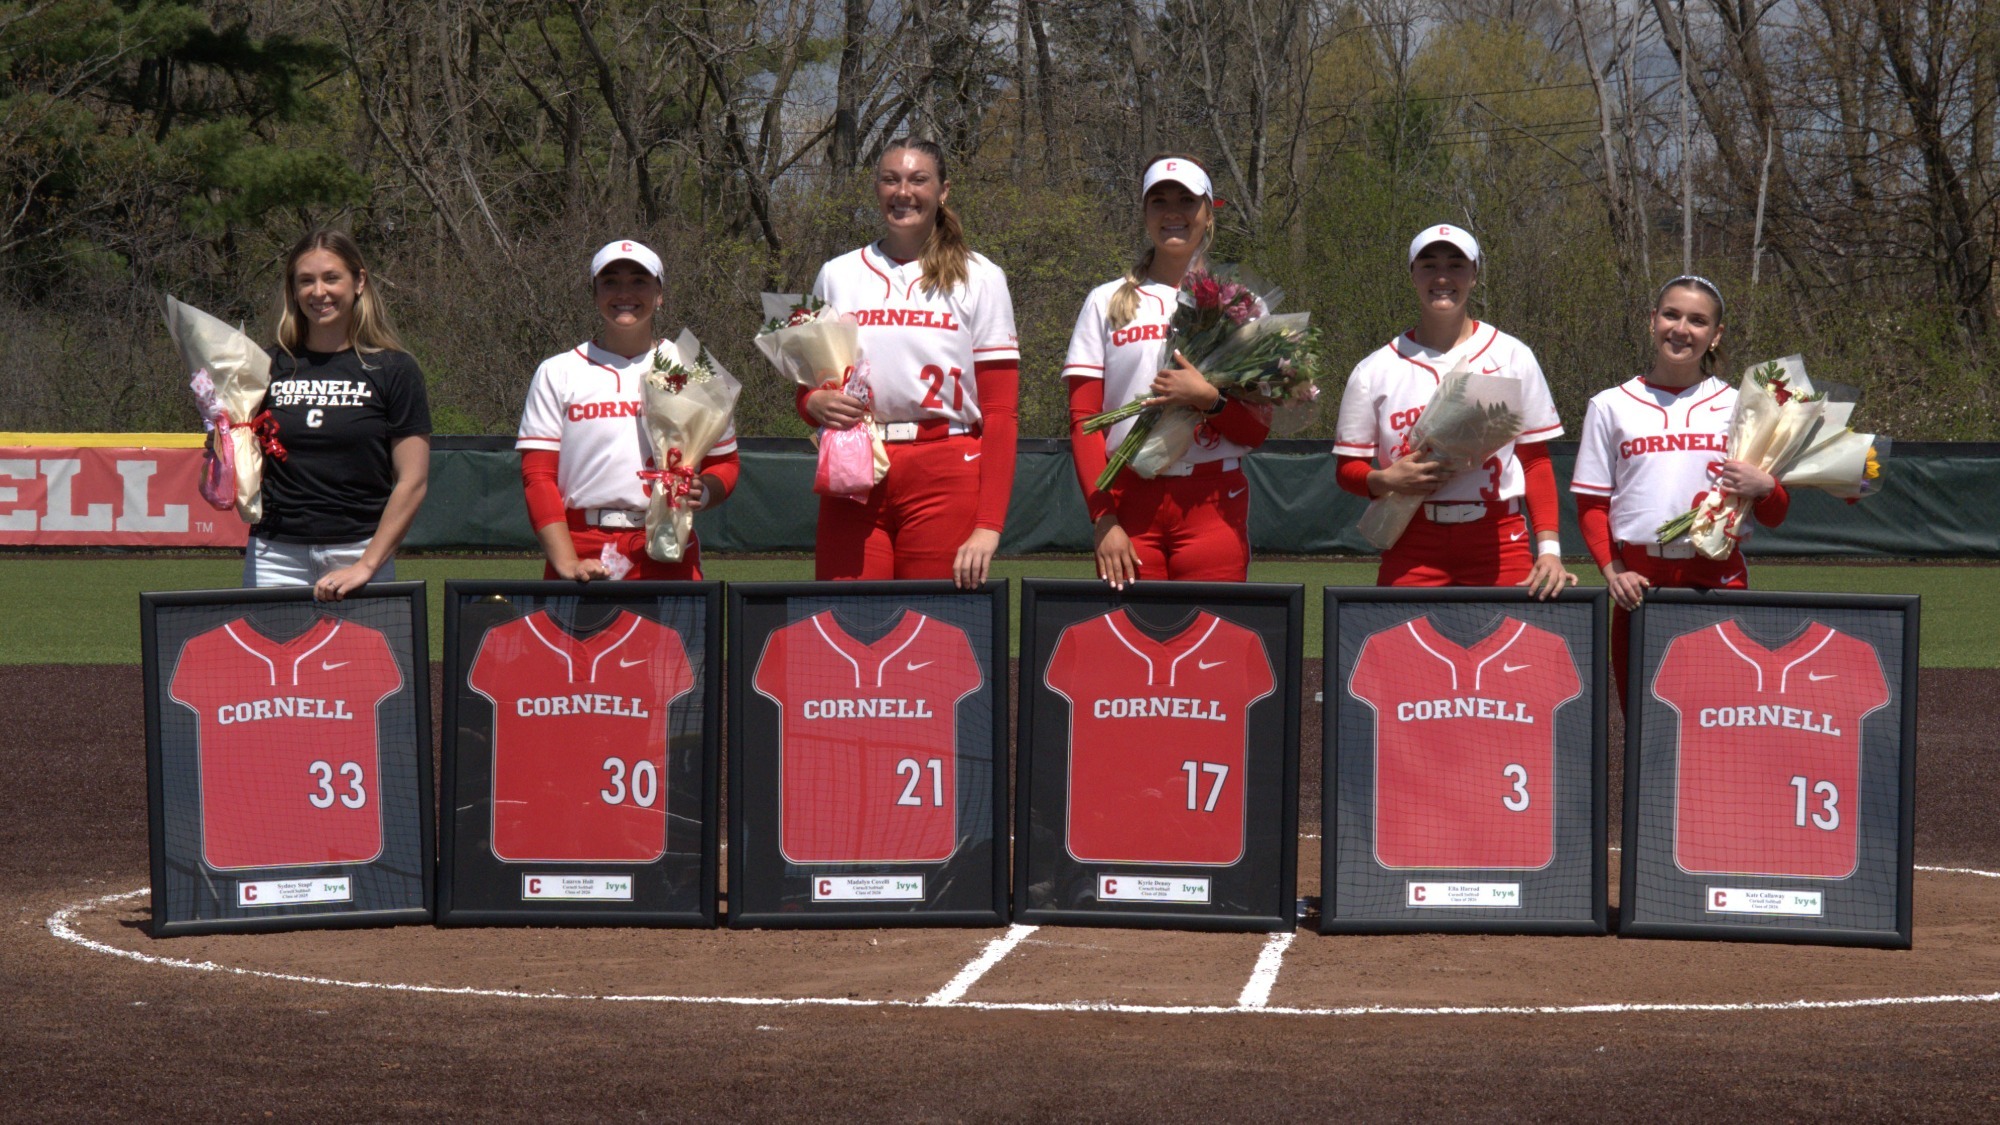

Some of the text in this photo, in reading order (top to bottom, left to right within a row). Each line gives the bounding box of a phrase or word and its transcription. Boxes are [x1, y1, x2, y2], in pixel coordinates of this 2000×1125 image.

[1166, 162, 1177, 171] C
[1439, 226, 1450, 236] C
[621, 242, 632, 252] C
[849, 309, 959, 331] ORNELL
[270, 380, 372, 397] CORNELL
[920, 364, 964, 411] 21
[275, 395, 364, 406] SOFTBALL
[306, 409, 324, 428] C
[1480, 456, 1503, 500] 3
[217, 697, 353, 725] CORNELL
[516, 694, 648, 719] CORNELL
[803, 698, 933, 719] CORNELL
[1094, 697, 1227, 722] CORNELL
[1397, 697, 1534, 724] CORNELL
[1700, 705, 1841, 737] CORNELL
[308, 760, 367, 809] 33
[600, 757, 657, 808] 30
[895, 757, 944, 807] 21
[1181, 760, 1230, 812] 17
[1502, 763, 1530, 812] 3
[1789, 774, 1840, 831] 13
[245, 885, 257, 901] C
[324, 884, 338, 893] Ivy
[529, 879, 541, 894] C
[605, 882, 620, 892] Ivy
[819, 880, 831, 896] C
[896, 882, 911, 891] Ivy
[1105, 879, 1117, 895] C
[1182, 884, 1197, 894] Ivy
[1414, 886, 1426, 901] C
[1492, 889, 1508, 899] Ivy
[1714, 891, 1727, 907] C
[1794, 896, 1810, 906] Ivy
